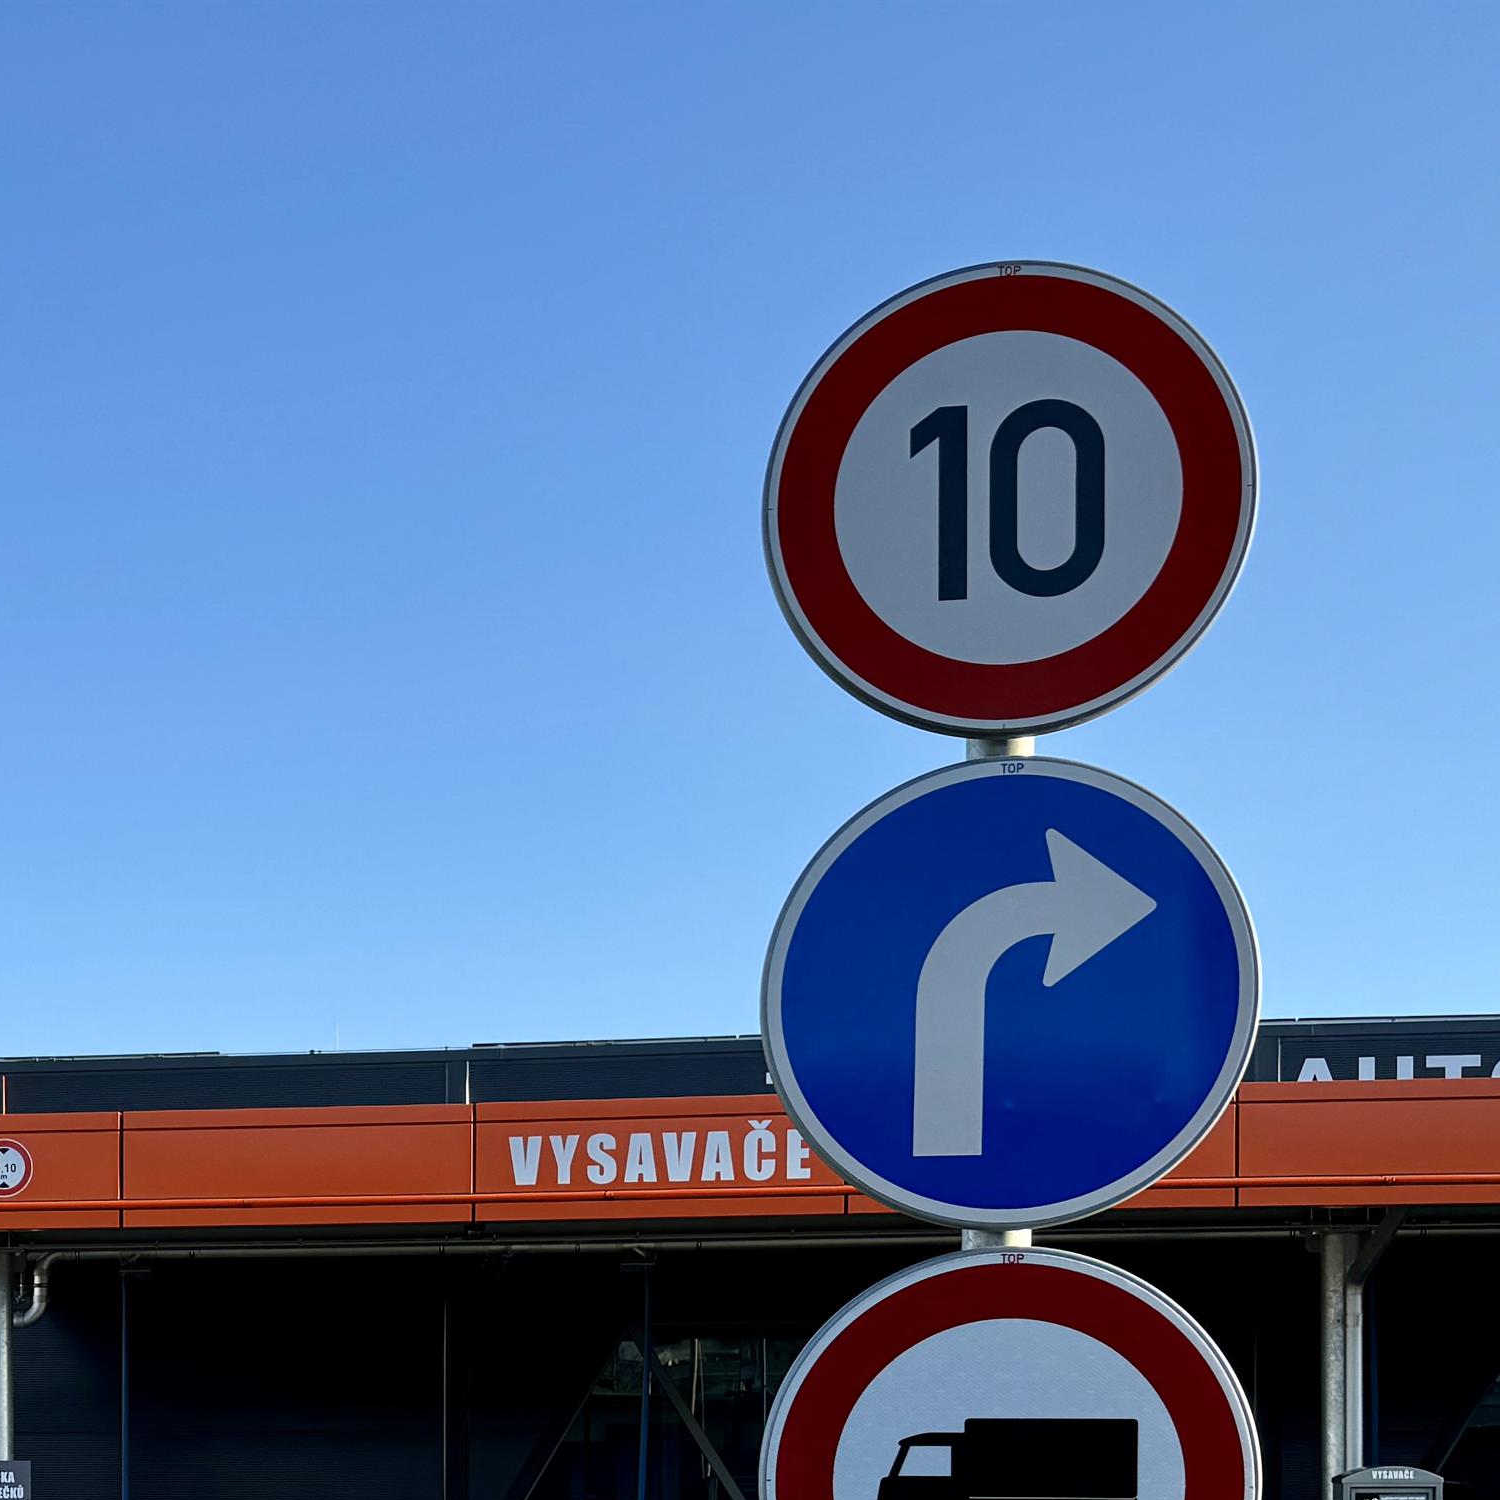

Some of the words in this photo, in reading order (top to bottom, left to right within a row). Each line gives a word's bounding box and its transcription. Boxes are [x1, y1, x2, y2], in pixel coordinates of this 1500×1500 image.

[997, 266, 1021, 277] TOP
[909, 398, 1105, 602] 10
[1000, 763, 1025, 773] TOP
[508, 1119, 811, 1186] VYSAVAČE
[1001, 1253, 1025, 1264] TOP
[1371, 1469, 1415, 1479] VYSAVAČE
